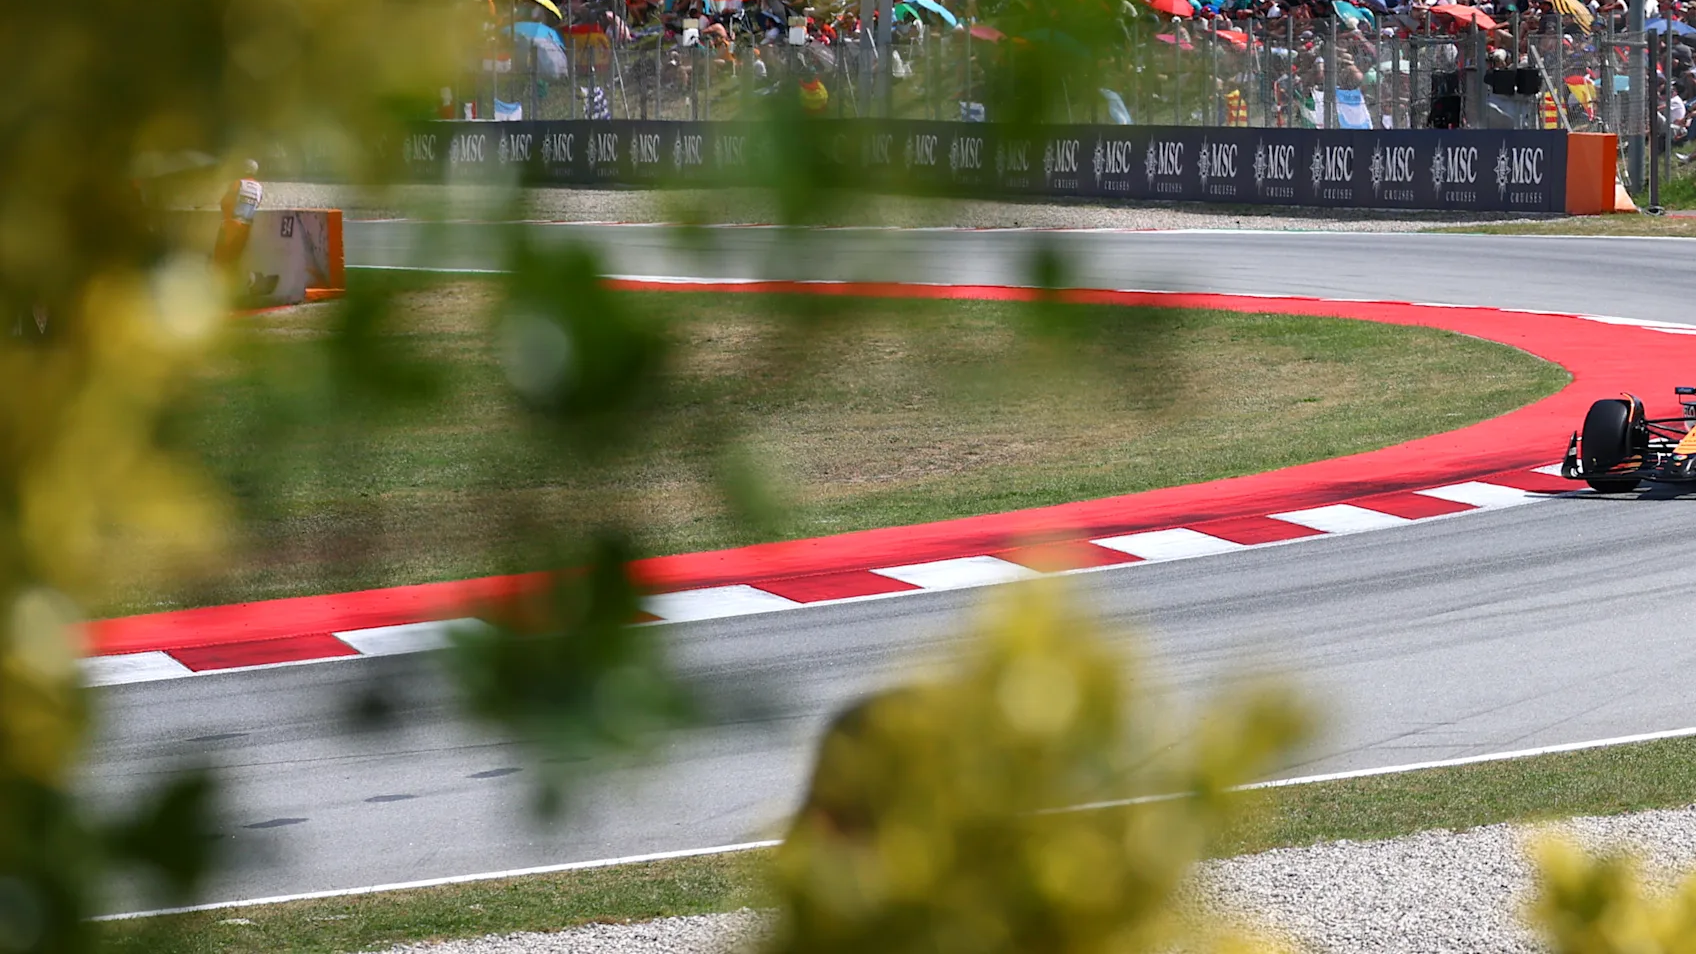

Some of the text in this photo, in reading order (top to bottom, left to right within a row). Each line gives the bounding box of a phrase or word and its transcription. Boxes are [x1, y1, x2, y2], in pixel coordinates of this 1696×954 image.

[413, 134, 436, 161] MSC
[460, 134, 486, 162] MSC
[509, 133, 532, 162] MSC
[552, 133, 574, 162] MSC
[598, 133, 618, 162] MSC
[638, 134, 660, 163] MSC
[684, 135, 703, 164] MSC
[914, 134, 937, 165] MSC
[960, 137, 983, 169] MSC
[1054, 139, 1079, 173] MSC
[1104, 140, 1131, 174] MSC
[1157, 141, 1184, 175] MSC
[1210, 143, 1237, 178] MSC
[1267, 144, 1295, 180] MSC
[1324, 146, 1354, 182] MSC
[1384, 146, 1415, 183] MSC
[1446, 147, 1478, 184] MSC
[1511, 147, 1544, 185] MSC
[1210, 184, 1236, 196] CRUISES
[1266, 186, 1294, 198] CRUISES
[1323, 188, 1352, 200] CRUISES
[1384, 189, 1414, 201] CRUISES
[1446, 191, 1476, 203] CRUISES
[1510, 192, 1542, 204] CRUISES
